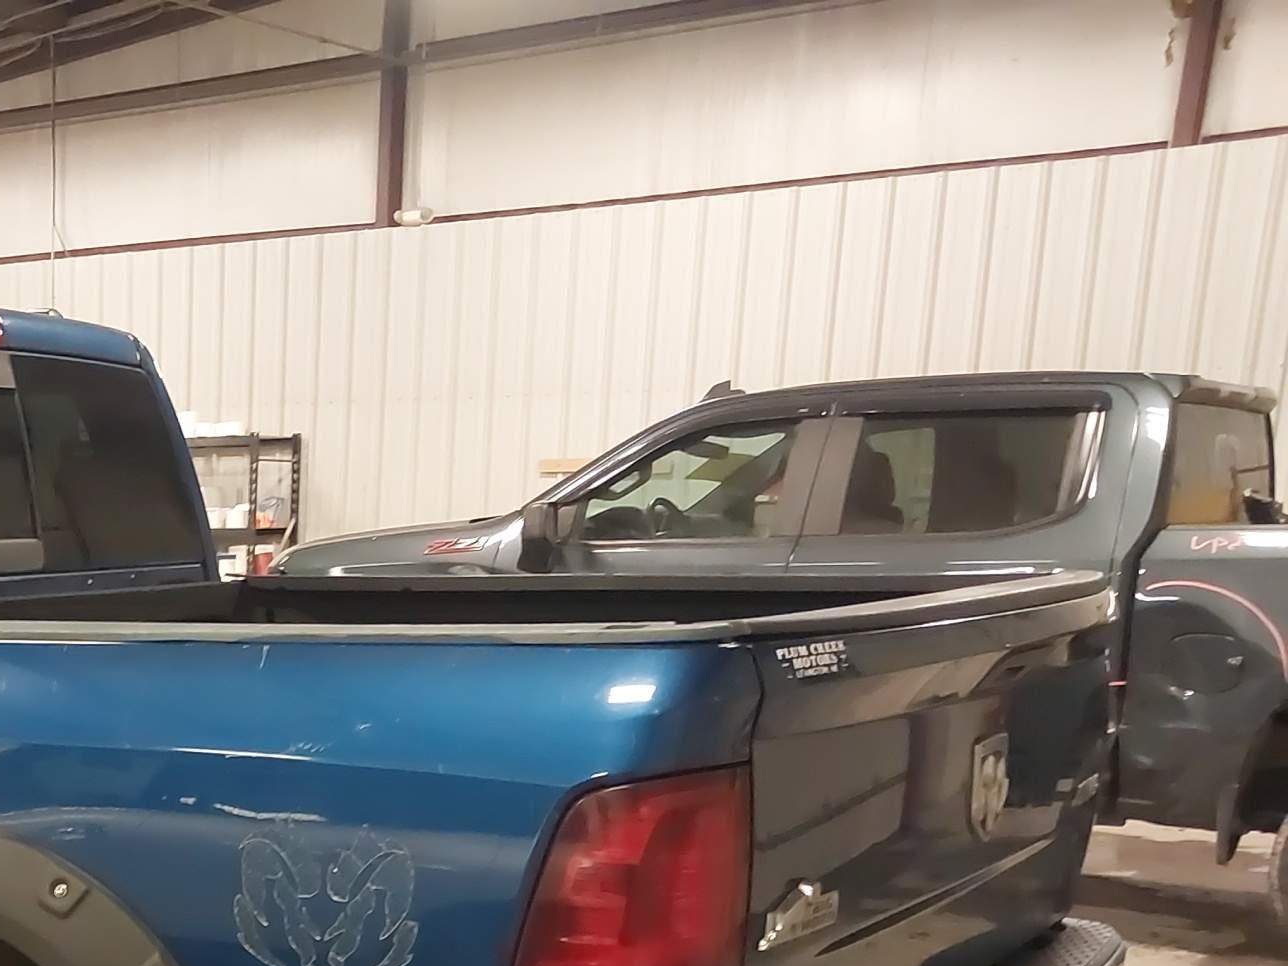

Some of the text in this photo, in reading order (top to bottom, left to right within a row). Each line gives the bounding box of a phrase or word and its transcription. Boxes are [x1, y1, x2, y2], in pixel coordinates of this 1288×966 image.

[776, 641, 846, 660] PLUM CREEK
[793, 654, 838, 669] MOTORS
